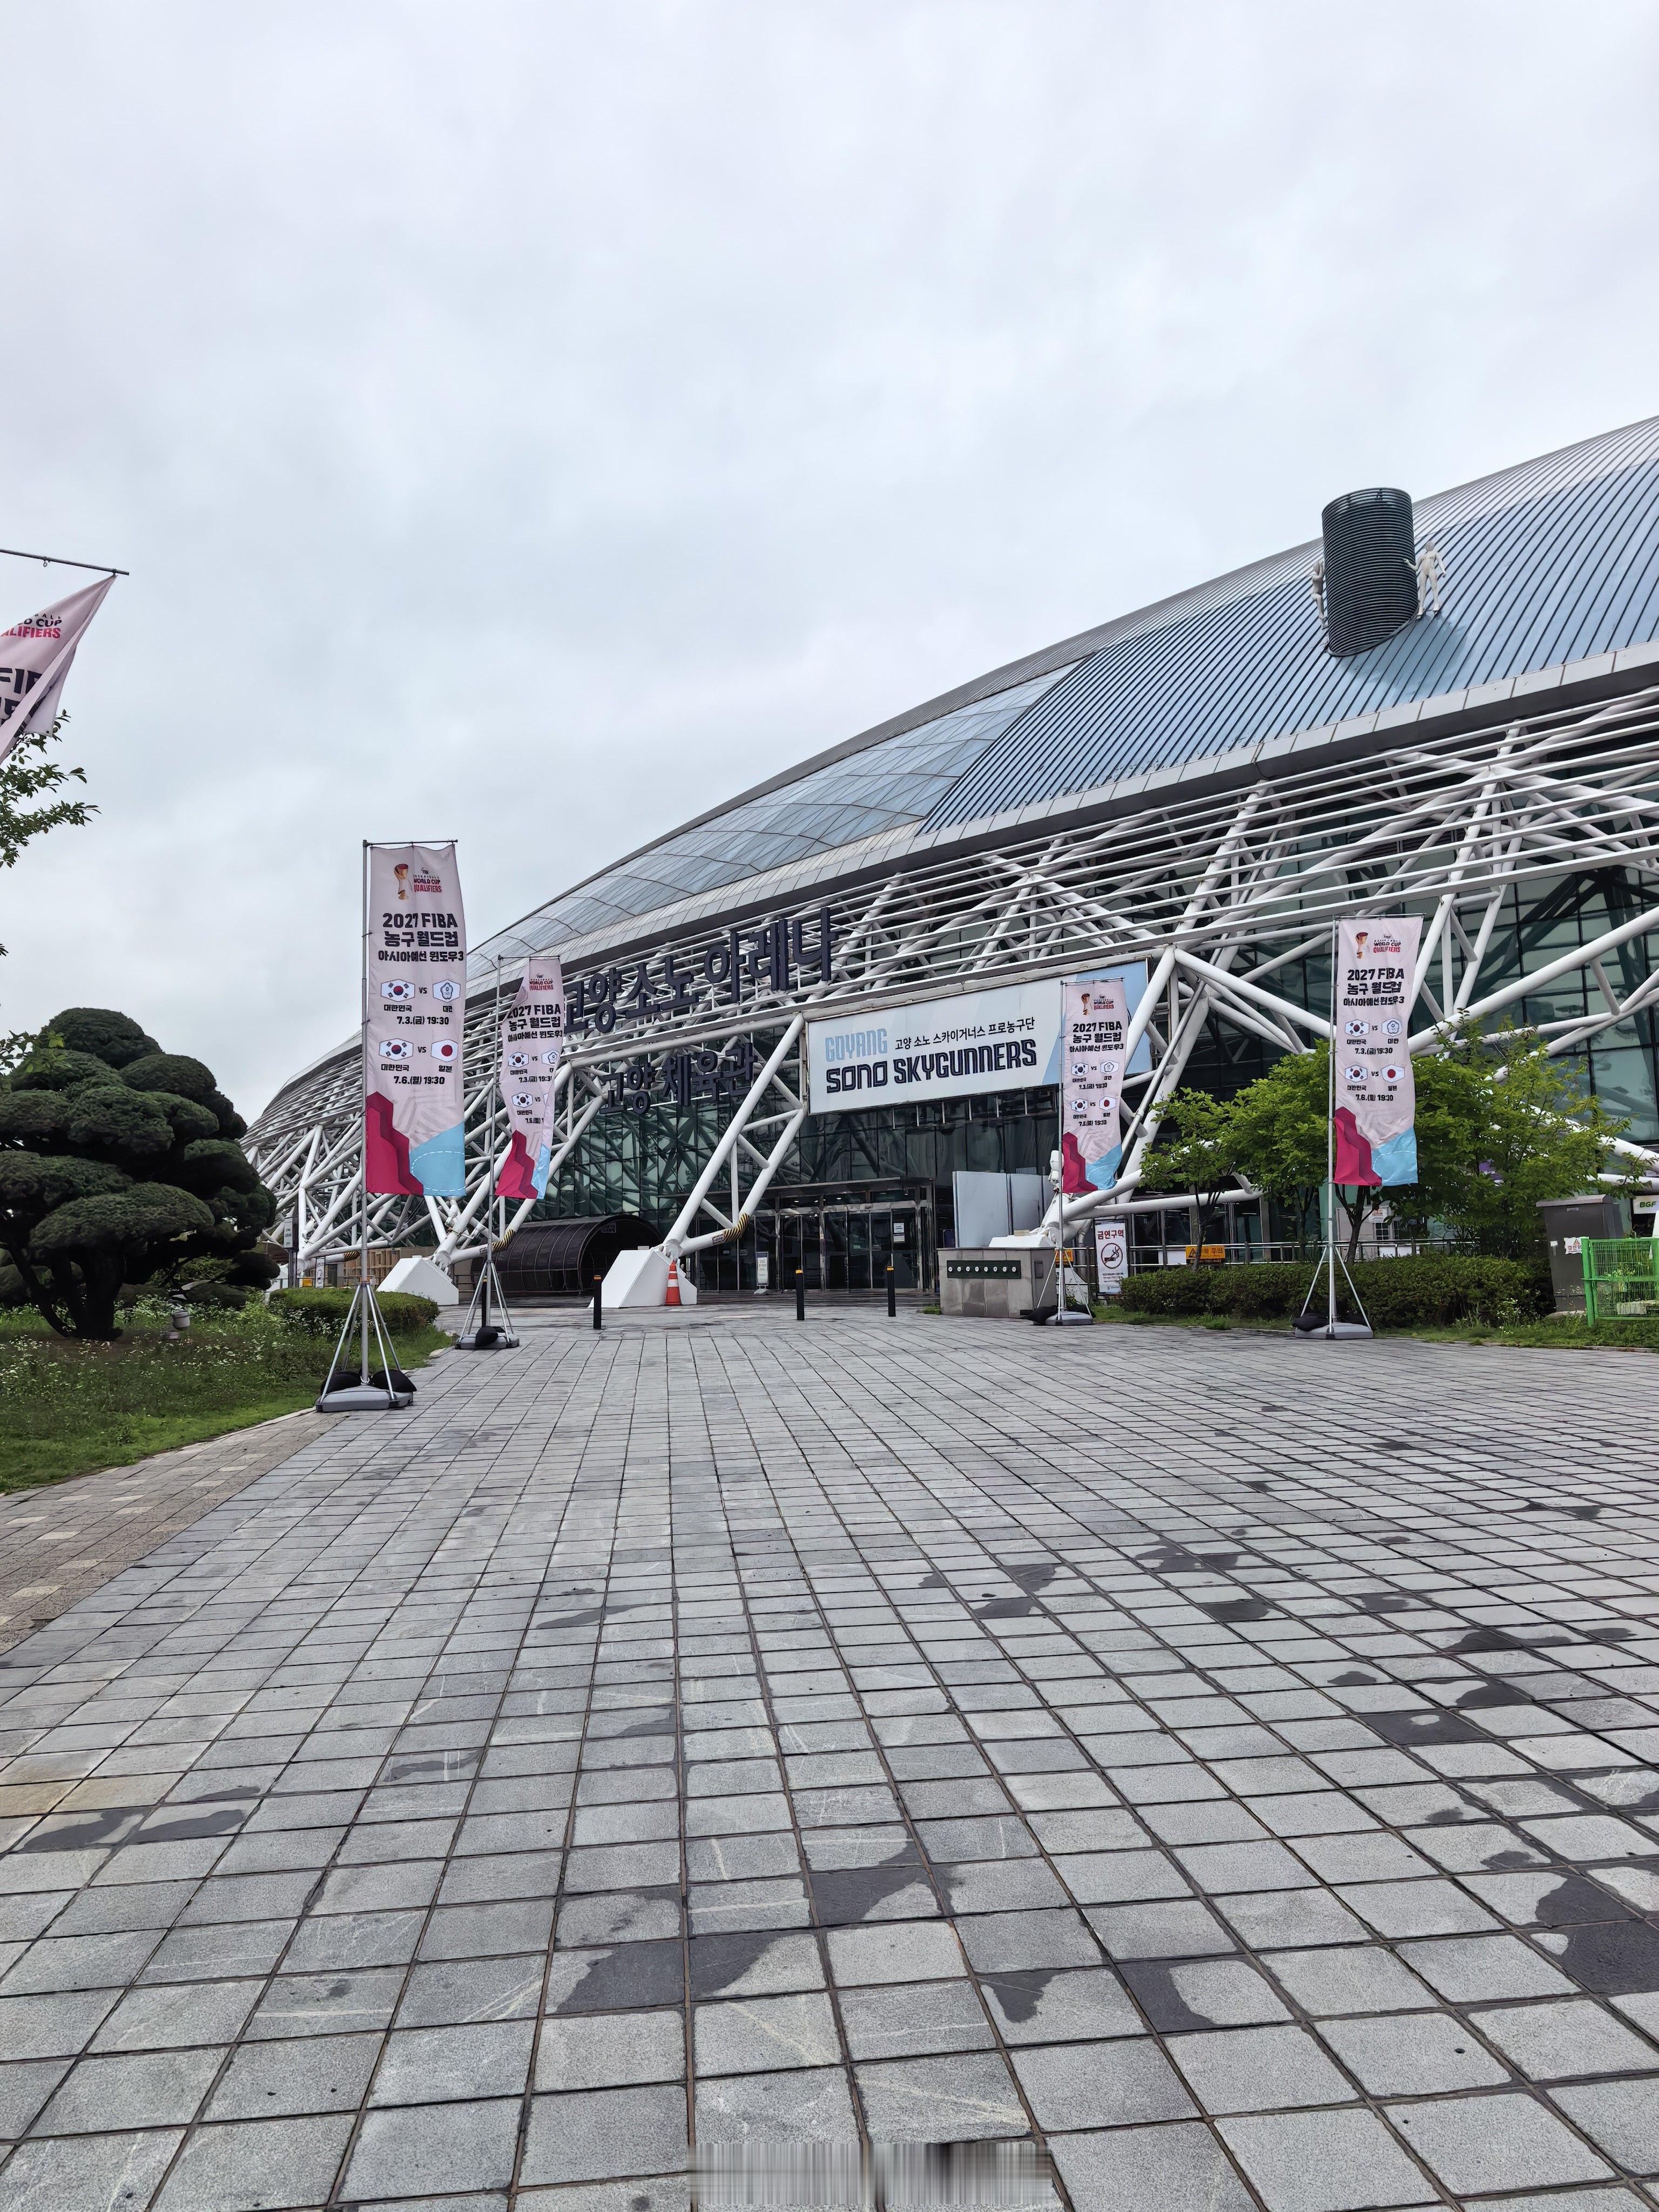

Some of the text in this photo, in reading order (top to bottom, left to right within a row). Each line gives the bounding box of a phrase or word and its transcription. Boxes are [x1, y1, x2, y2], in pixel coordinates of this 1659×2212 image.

[414, 884, 442, 893] QUALIFIERS
[382, 913, 458, 928] 2027 FIBA
[384, 931, 459, 947] 농구 월드컵
[378, 950, 464, 962] 아시아예선 윈도우3
[1347, 969, 1375, 981] 2027
[1347, 981, 1402, 995] 농구 월드컵
[1343, 997, 1379, 1006] 아시아예선
[534, 1004, 561, 1015] FIBA
[396, 1016, 449, 1025] 7.3.(금) 19:30
[509, 1016, 561, 1031] 농구 월드컵
[1073, 1021, 1123, 1033] 2027 FIBA
[508, 1031, 538, 1042] 아시아예선
[895, 1016, 1035, 1050] 고양 소노 스카이거너스 프로농구단
[1073, 1032, 1122, 1044] 농구 월드컵
[1102, 1043, 1124, 1051] 윈도우3
[381, 1063, 410, 1071] 대한민국
[423, 1076, 445, 1085] 19:30
[1097, 1229, 1124, 1240] 금연구역
